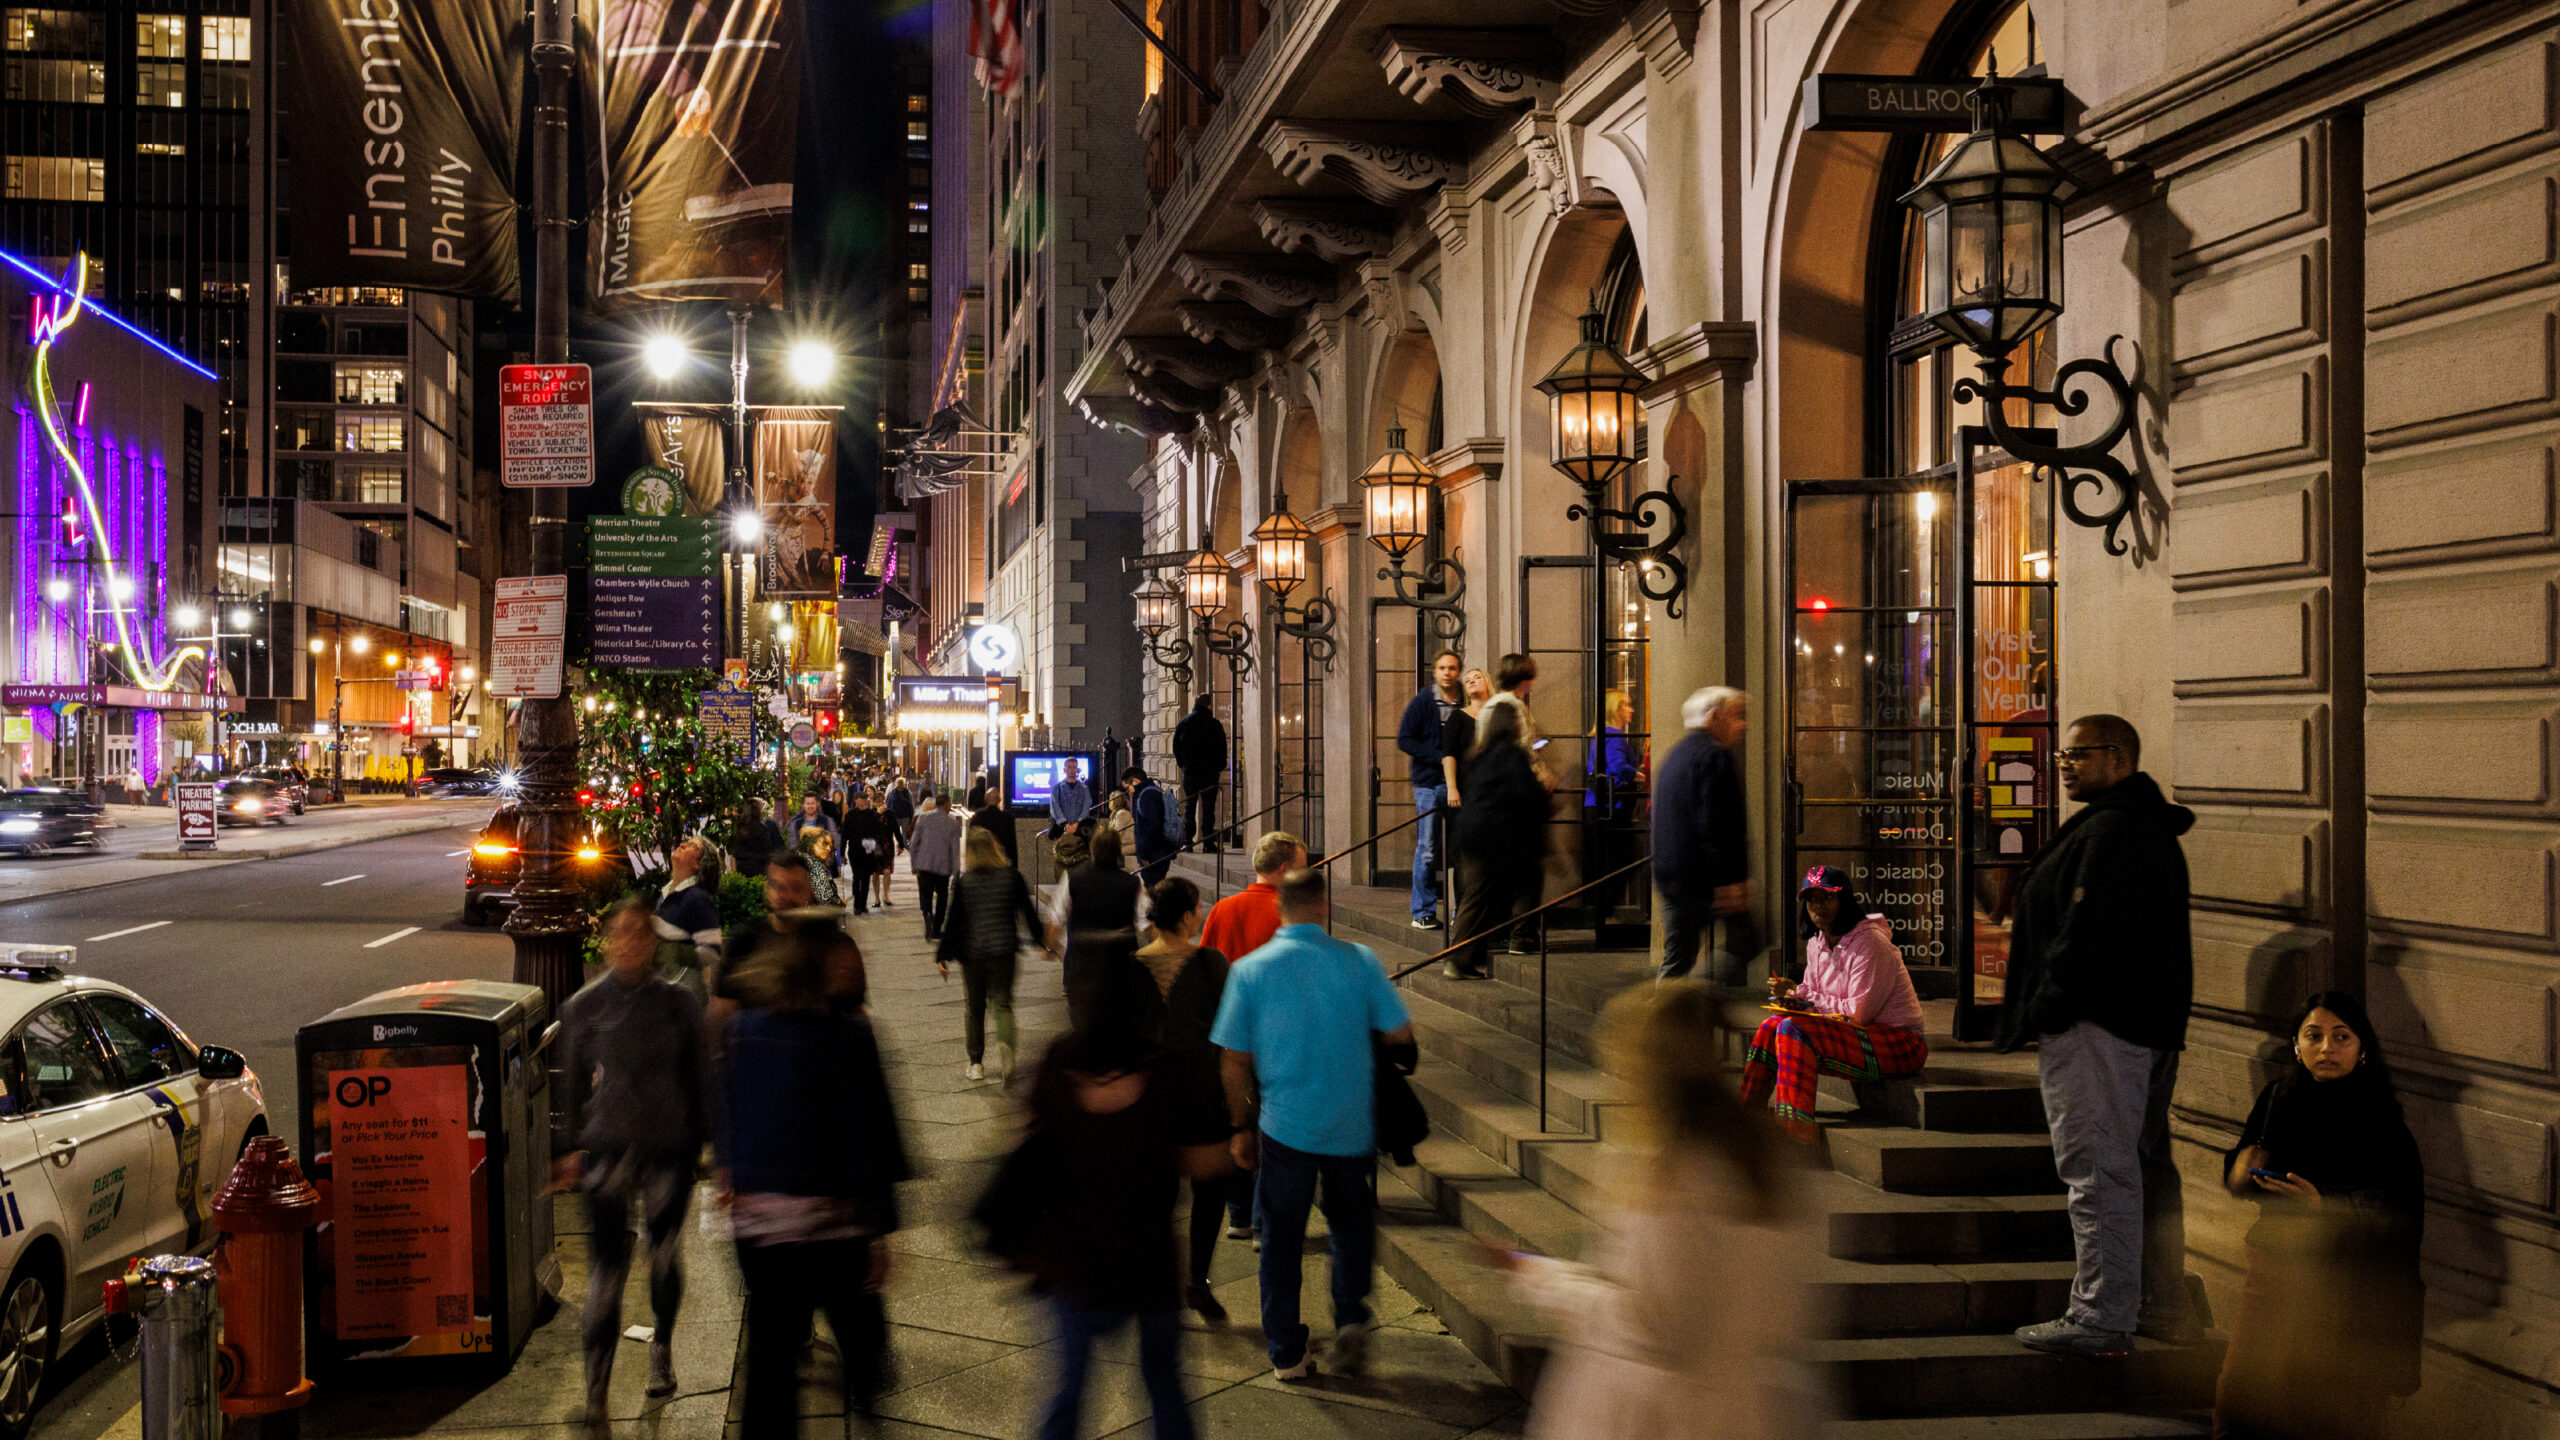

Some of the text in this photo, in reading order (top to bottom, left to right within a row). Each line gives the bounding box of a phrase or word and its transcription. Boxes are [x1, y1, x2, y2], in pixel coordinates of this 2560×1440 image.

[1867, 88, 1975, 112] BALLROO
[342, 0, 407, 259] Ensemb
[431, 148, 472, 267] Philly
[609, 191, 634, 285] Music
[523, 369, 567, 380] SNOW
[503, 381, 586, 392] EMERGENCY
[522, 392, 569, 403] ROUTE
[513, 406, 537, 414] SNOW
[540, 405, 563, 413] TIRES
[508, 412, 584, 421] CHAINS REQUIRED
[540, 430, 584, 438] EMERGENCY
[507, 439, 541, 447] VEHICLES
[544, 438, 576, 446] SUBJECT
[595, 519, 661, 527] Merriam Theater
[594, 533, 678, 543] University of the Arts
[1133, 557, 1160, 567] TICKET
[594, 564, 652, 572] Kimmel Center
[594, 579, 690, 589] Chambers-Wylie Church
[595, 594, 627, 603] Antique
[495, 604, 547, 618] NO STOPPING
[594, 609, 636, 617] Gershman
[595, 624, 653, 632] Wilma Theater
[594, 639, 698, 649] Historical Soc./Library Co.
[1983, 628, 2037, 651] Visit
[495, 641, 560, 654] PASSENGER VEHICLE
[752, 638, 762, 664] Philly
[499, 655, 554, 667] LOADING ONLY
[594, 655, 620, 663] PATCO
[1982, 656, 2032, 681] Our
[732, 671, 740, 681] 17
[9, 687, 46, 698] WILMA
[913, 687, 950, 702] Miller
[200, 695, 228, 710] AURRA
[1982, 687, 2046, 710] Venu
[257, 722, 280, 734] BAR
[180, 788, 213, 799] THEATRE
[180, 800, 213, 811] PARKING
[373, 1024, 418, 1041] Bigbelly
[336, 1076, 391, 1108] OP
[341, 1117, 429, 1132] Any seat for $11
[341, 1129, 438, 1144] or Pick Your Price
[384, 1153, 424, 1163] Machina
[92, 1165, 127, 1196] ELECTRIC
[353, 1204, 370, 1212] The
[355, 1279, 373, 1287] The
